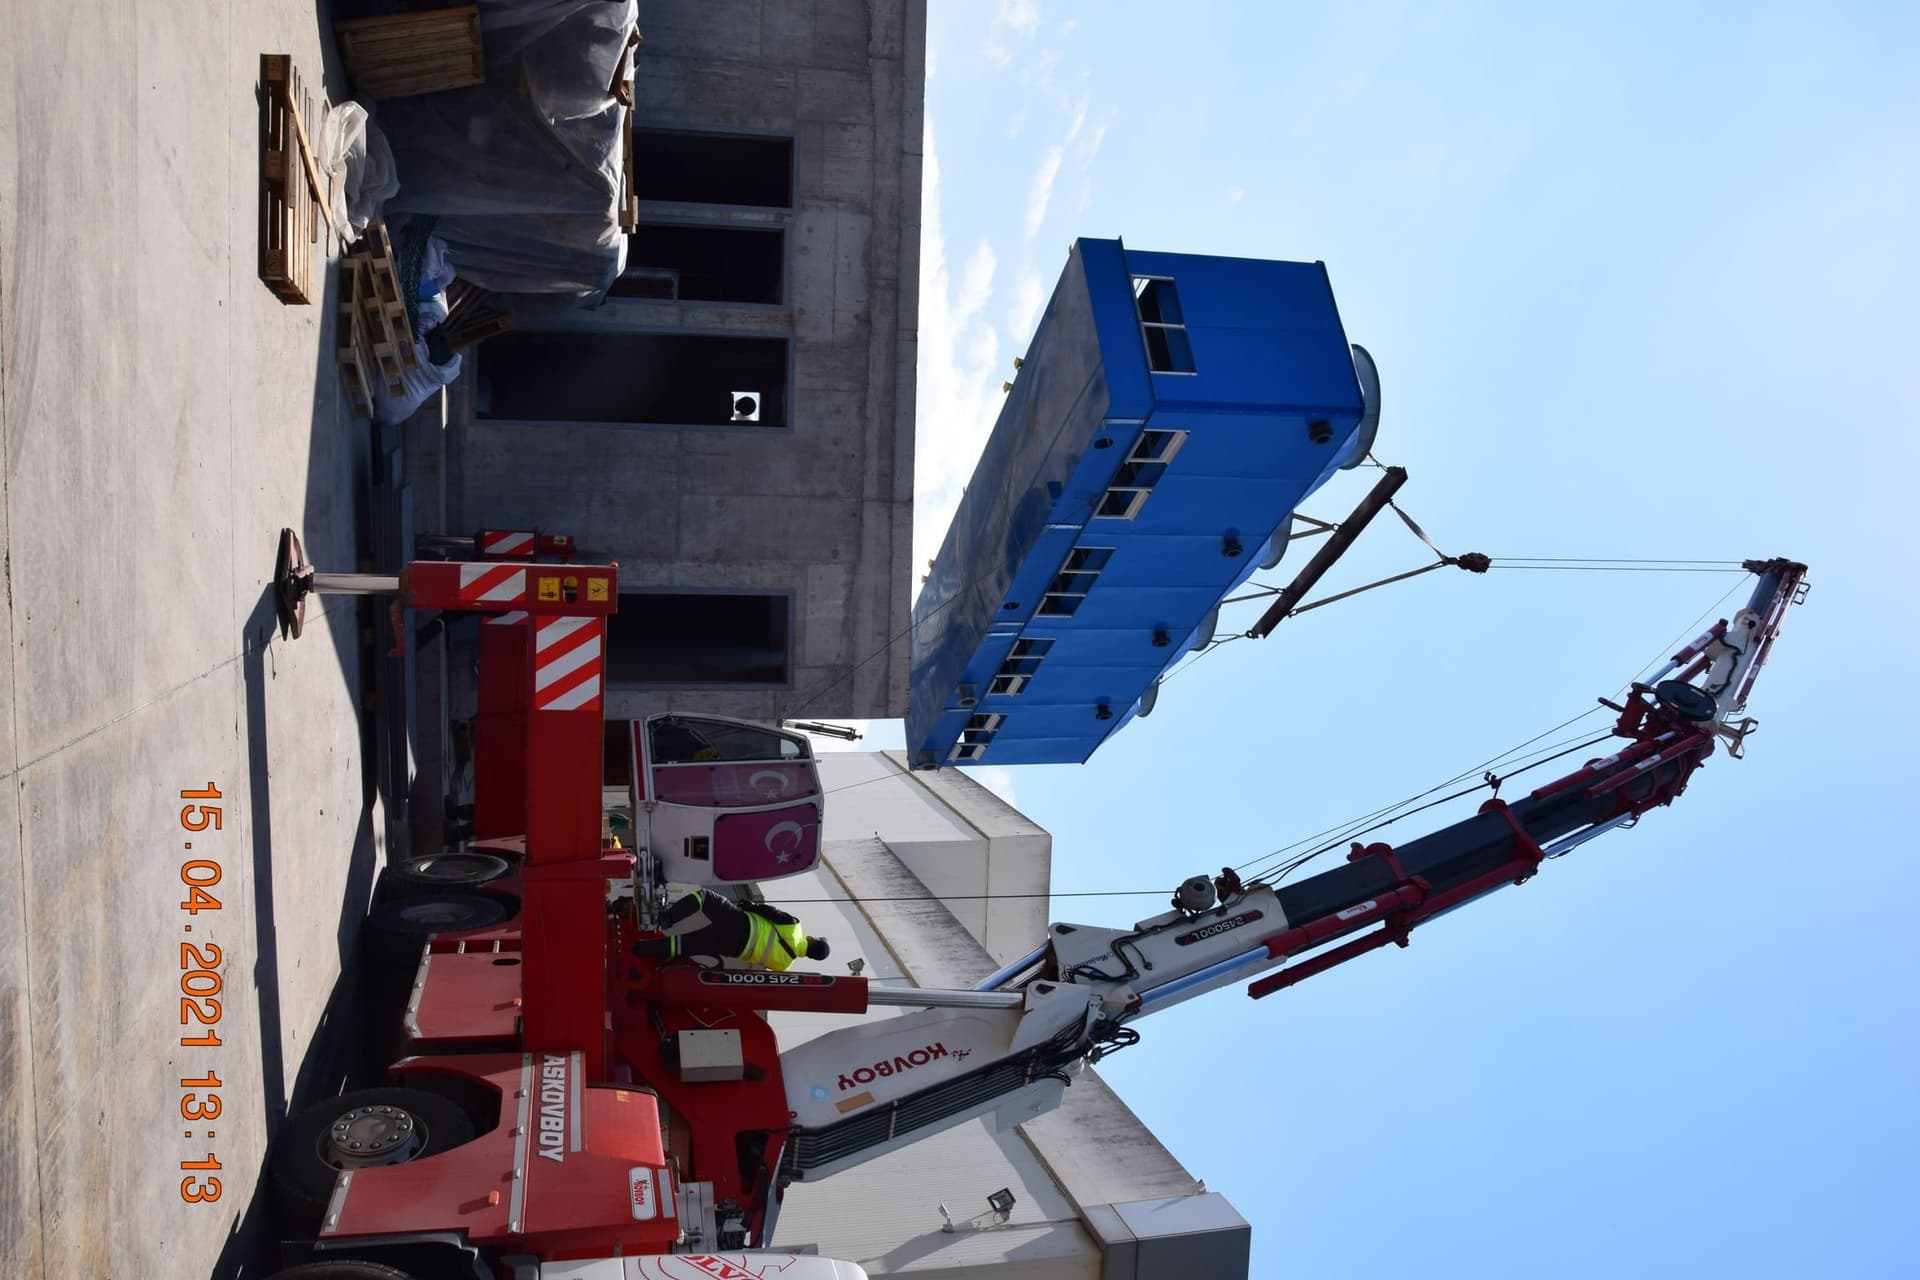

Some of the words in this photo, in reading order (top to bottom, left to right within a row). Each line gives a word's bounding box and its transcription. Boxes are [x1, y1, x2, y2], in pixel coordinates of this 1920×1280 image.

[769, 974, 800, 984] 245
[838, 1042, 948, 1091] KOVBOY
[538, 1055, 566, 1162] ASKOVBOY
